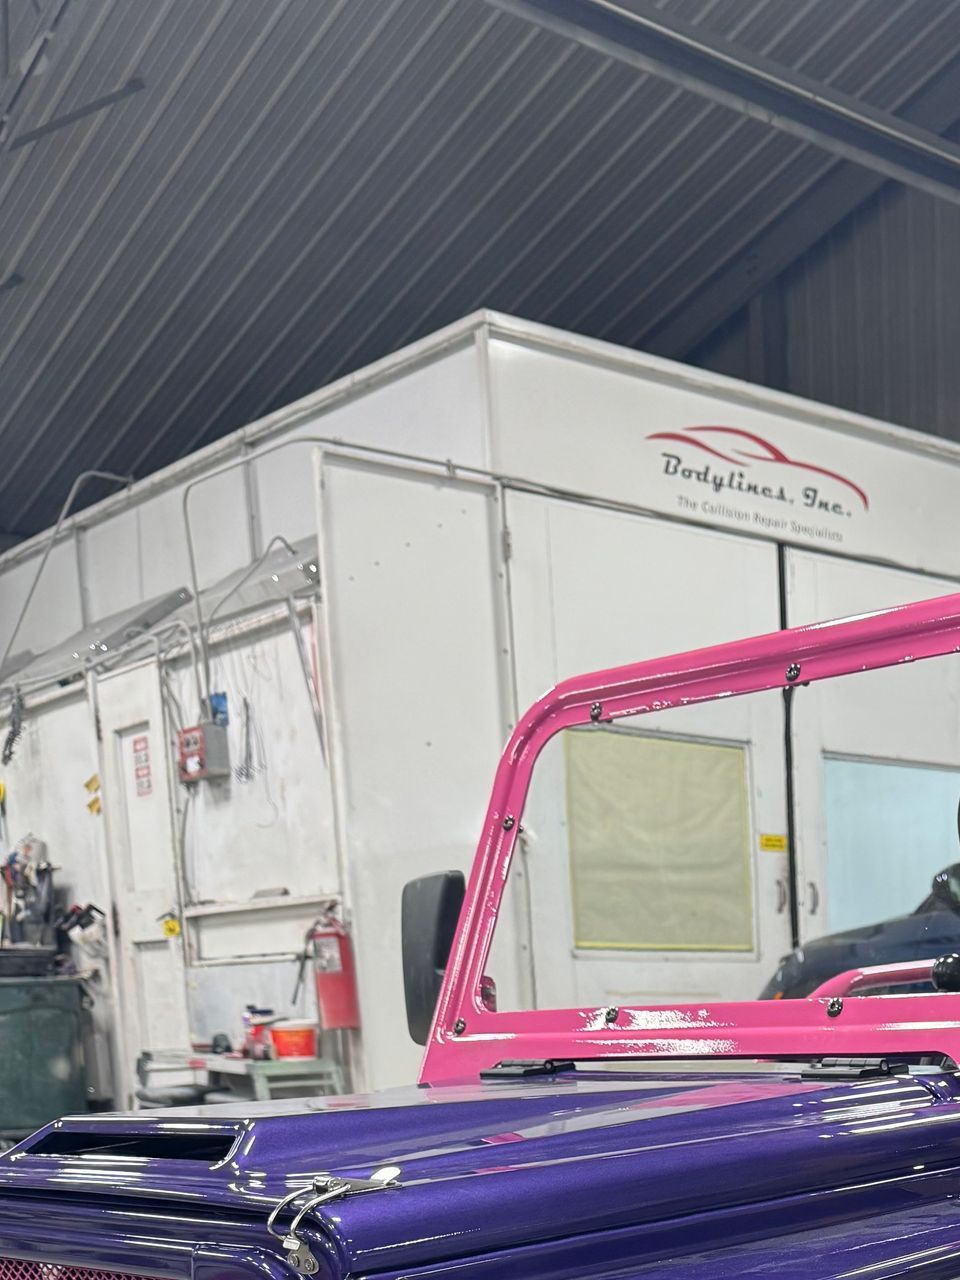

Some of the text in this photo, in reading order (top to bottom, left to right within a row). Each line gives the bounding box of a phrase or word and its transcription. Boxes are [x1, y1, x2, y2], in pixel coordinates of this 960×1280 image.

[677, 495, 844, 542] The Collision Repair Specialists
[802, 486, 853, 519] Inc.
